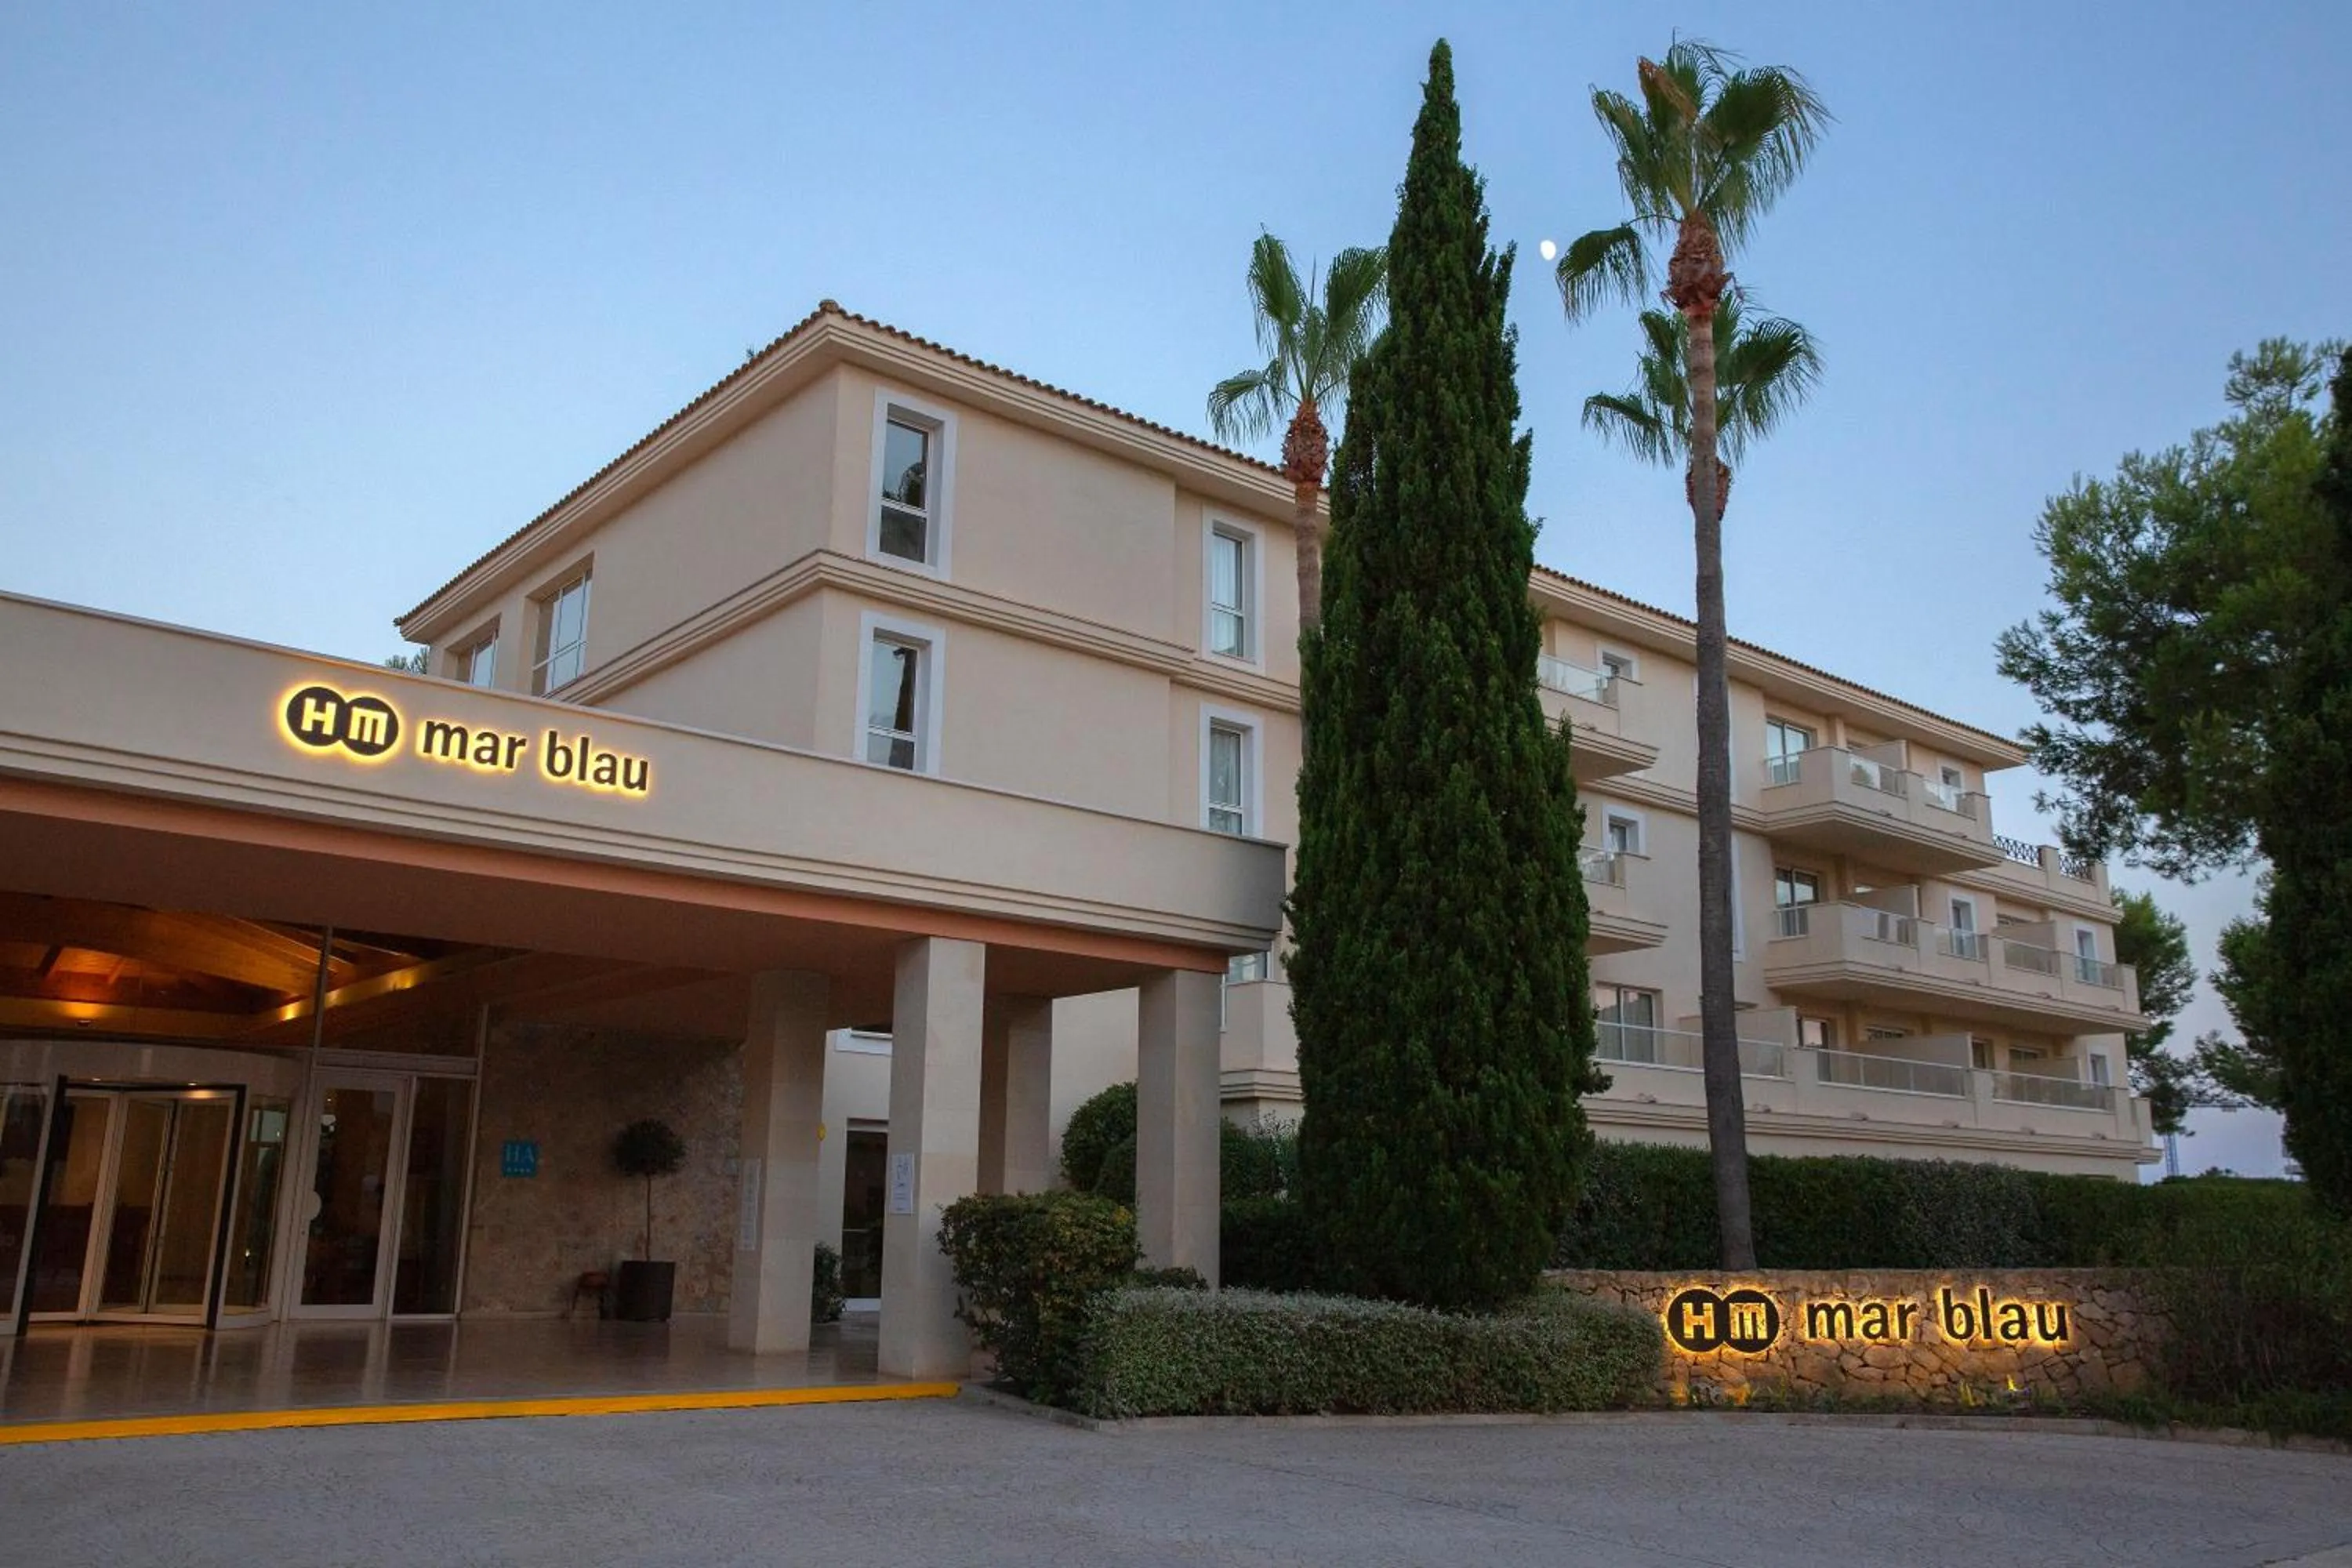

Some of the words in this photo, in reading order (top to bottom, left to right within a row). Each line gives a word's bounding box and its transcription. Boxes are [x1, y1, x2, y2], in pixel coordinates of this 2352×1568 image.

[423, 719, 527, 770] mar
[546, 730, 649, 791] blau
[1806, 1300, 1917, 1340] mar
[1940, 1287, 2069, 1341] blau
